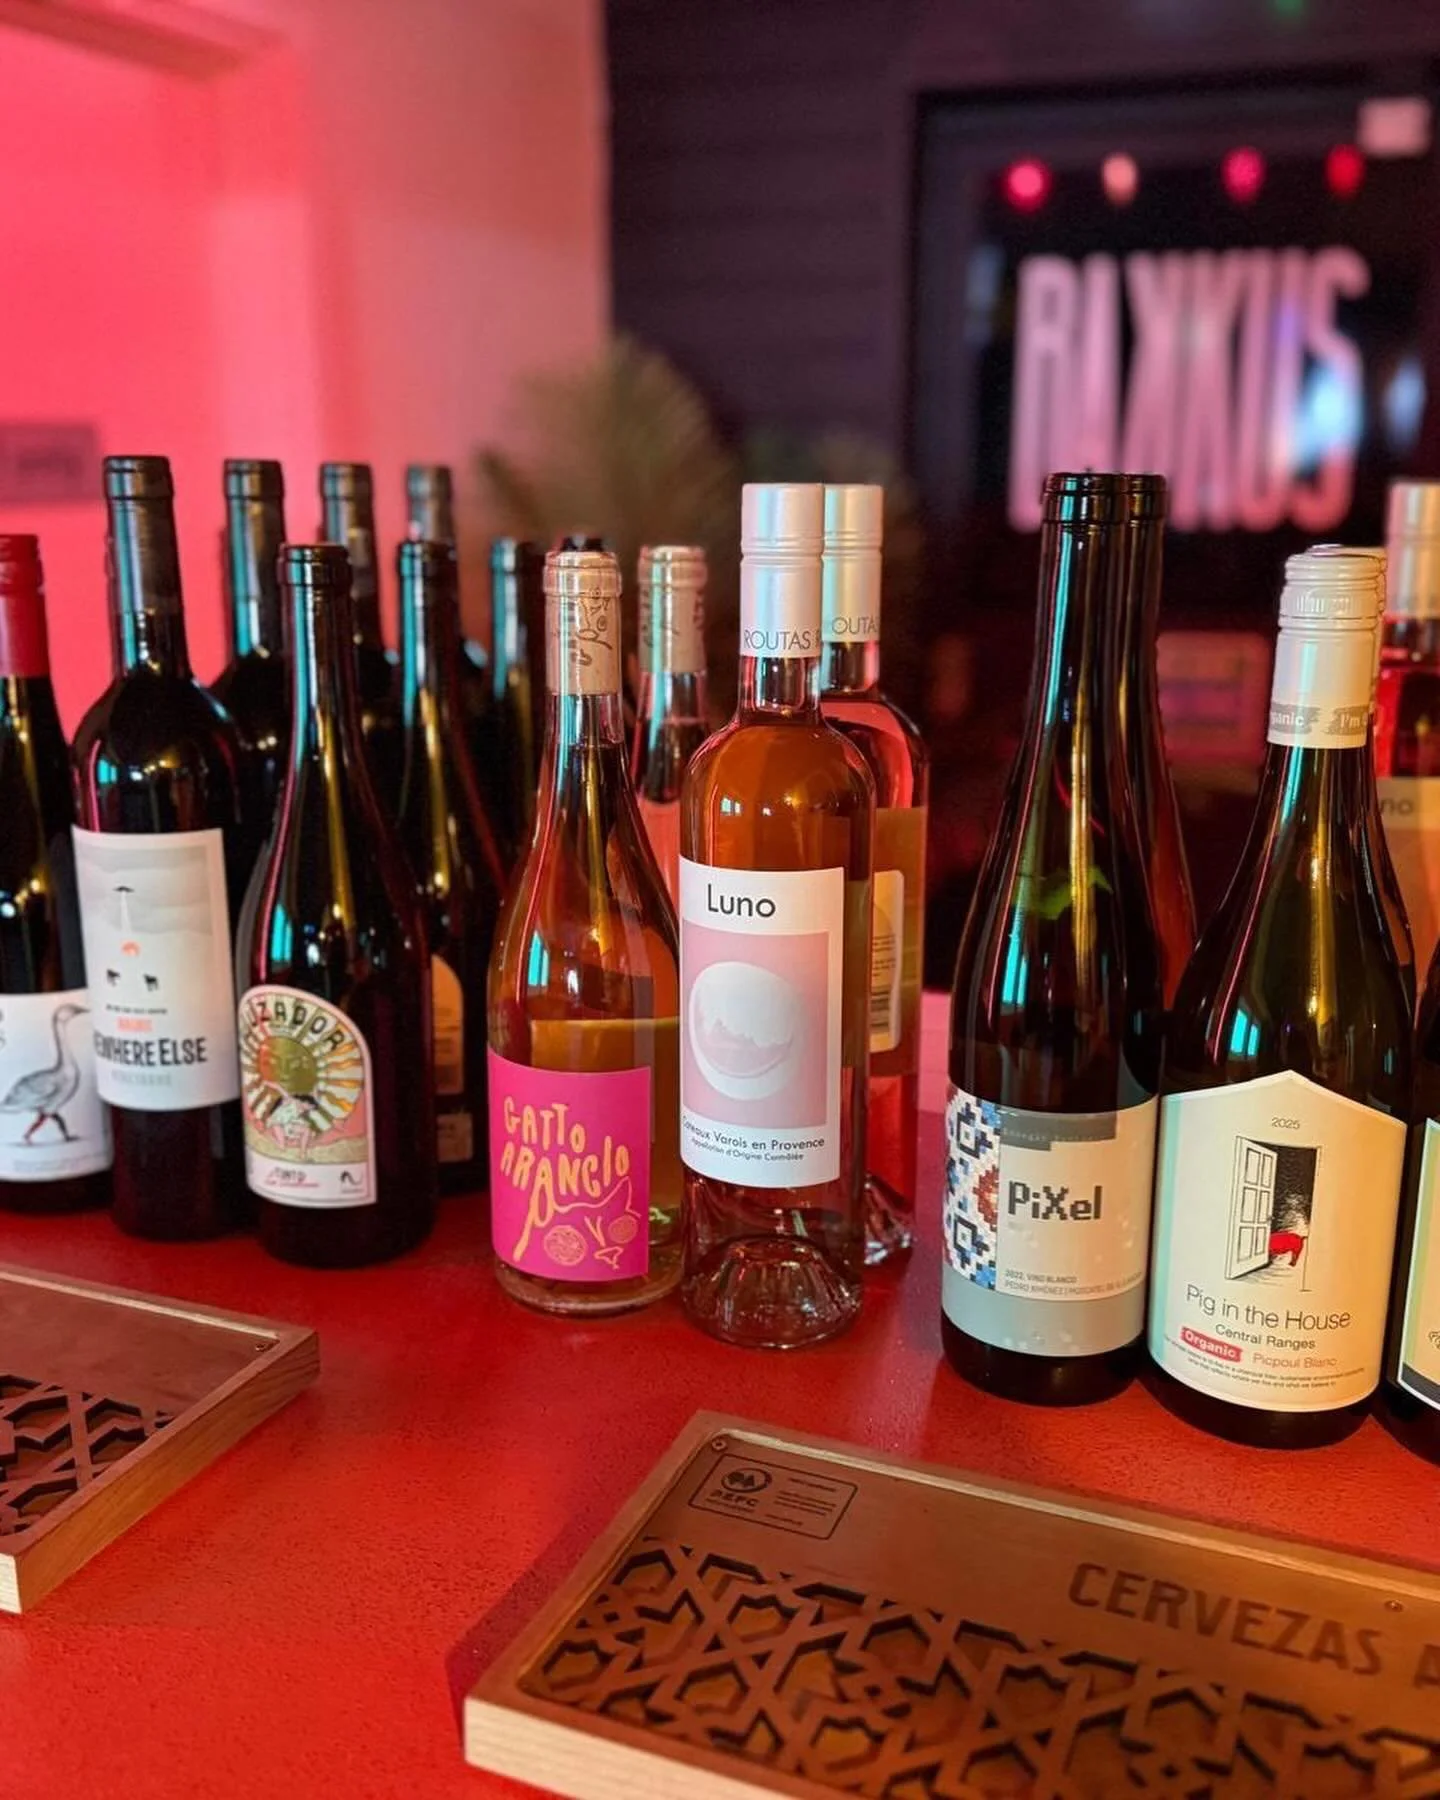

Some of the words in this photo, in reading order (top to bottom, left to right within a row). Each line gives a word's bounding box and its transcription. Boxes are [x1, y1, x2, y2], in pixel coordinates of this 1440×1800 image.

[744, 630, 811, 650] ROUTAS
[708, 883, 776, 918] Luno
[503, 1095, 586, 1153] GATTO
[683, 1115, 711, 1140] oteaux
[713, 1131, 747, 1149] Varois
[752, 1141, 767, 1150] en
[771, 1138, 825, 1151] Provence
[1271, 1116, 1300, 1130] 2025
[500, 1135, 630, 1222] ARANCIO
[1008, 1181, 1103, 1221] PiXel
[1186, 1284, 1216, 1316] Pig
[1222, 1299, 1239, 1321] in
[1245, 1305, 1279, 1328] the
[1285, 1310, 1351, 1331] House
[1185, 1331, 1236, 1358] Organic
[1252, 1353, 1300, 1369] Picpoul
[1304, 1357, 1338, 1369] Blanc
[1215, 1324, 1262, 1345] Central
[1266, 1336, 1316, 1350] Ranges
[1069, 1562, 1383, 1676] CERVEZAS
